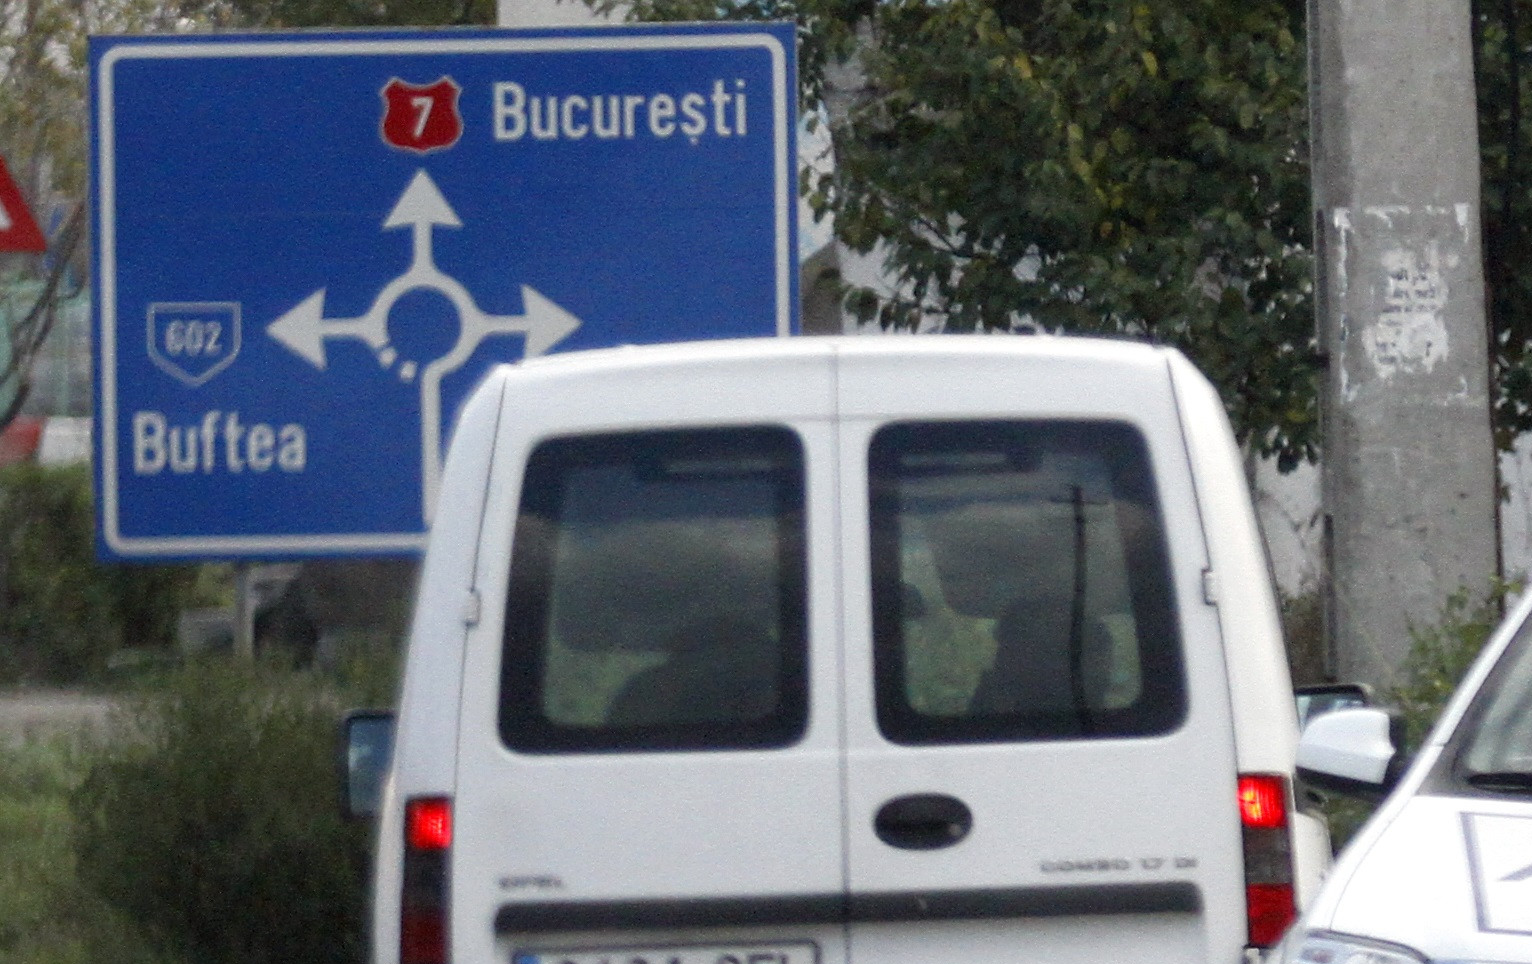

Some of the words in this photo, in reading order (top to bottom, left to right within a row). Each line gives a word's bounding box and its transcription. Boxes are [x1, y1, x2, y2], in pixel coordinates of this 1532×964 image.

[411, 96, 434, 139] 7
[492, 78, 748, 146] București
[165, 319, 223, 357] 602
[132, 410, 308, 476] Buftea
